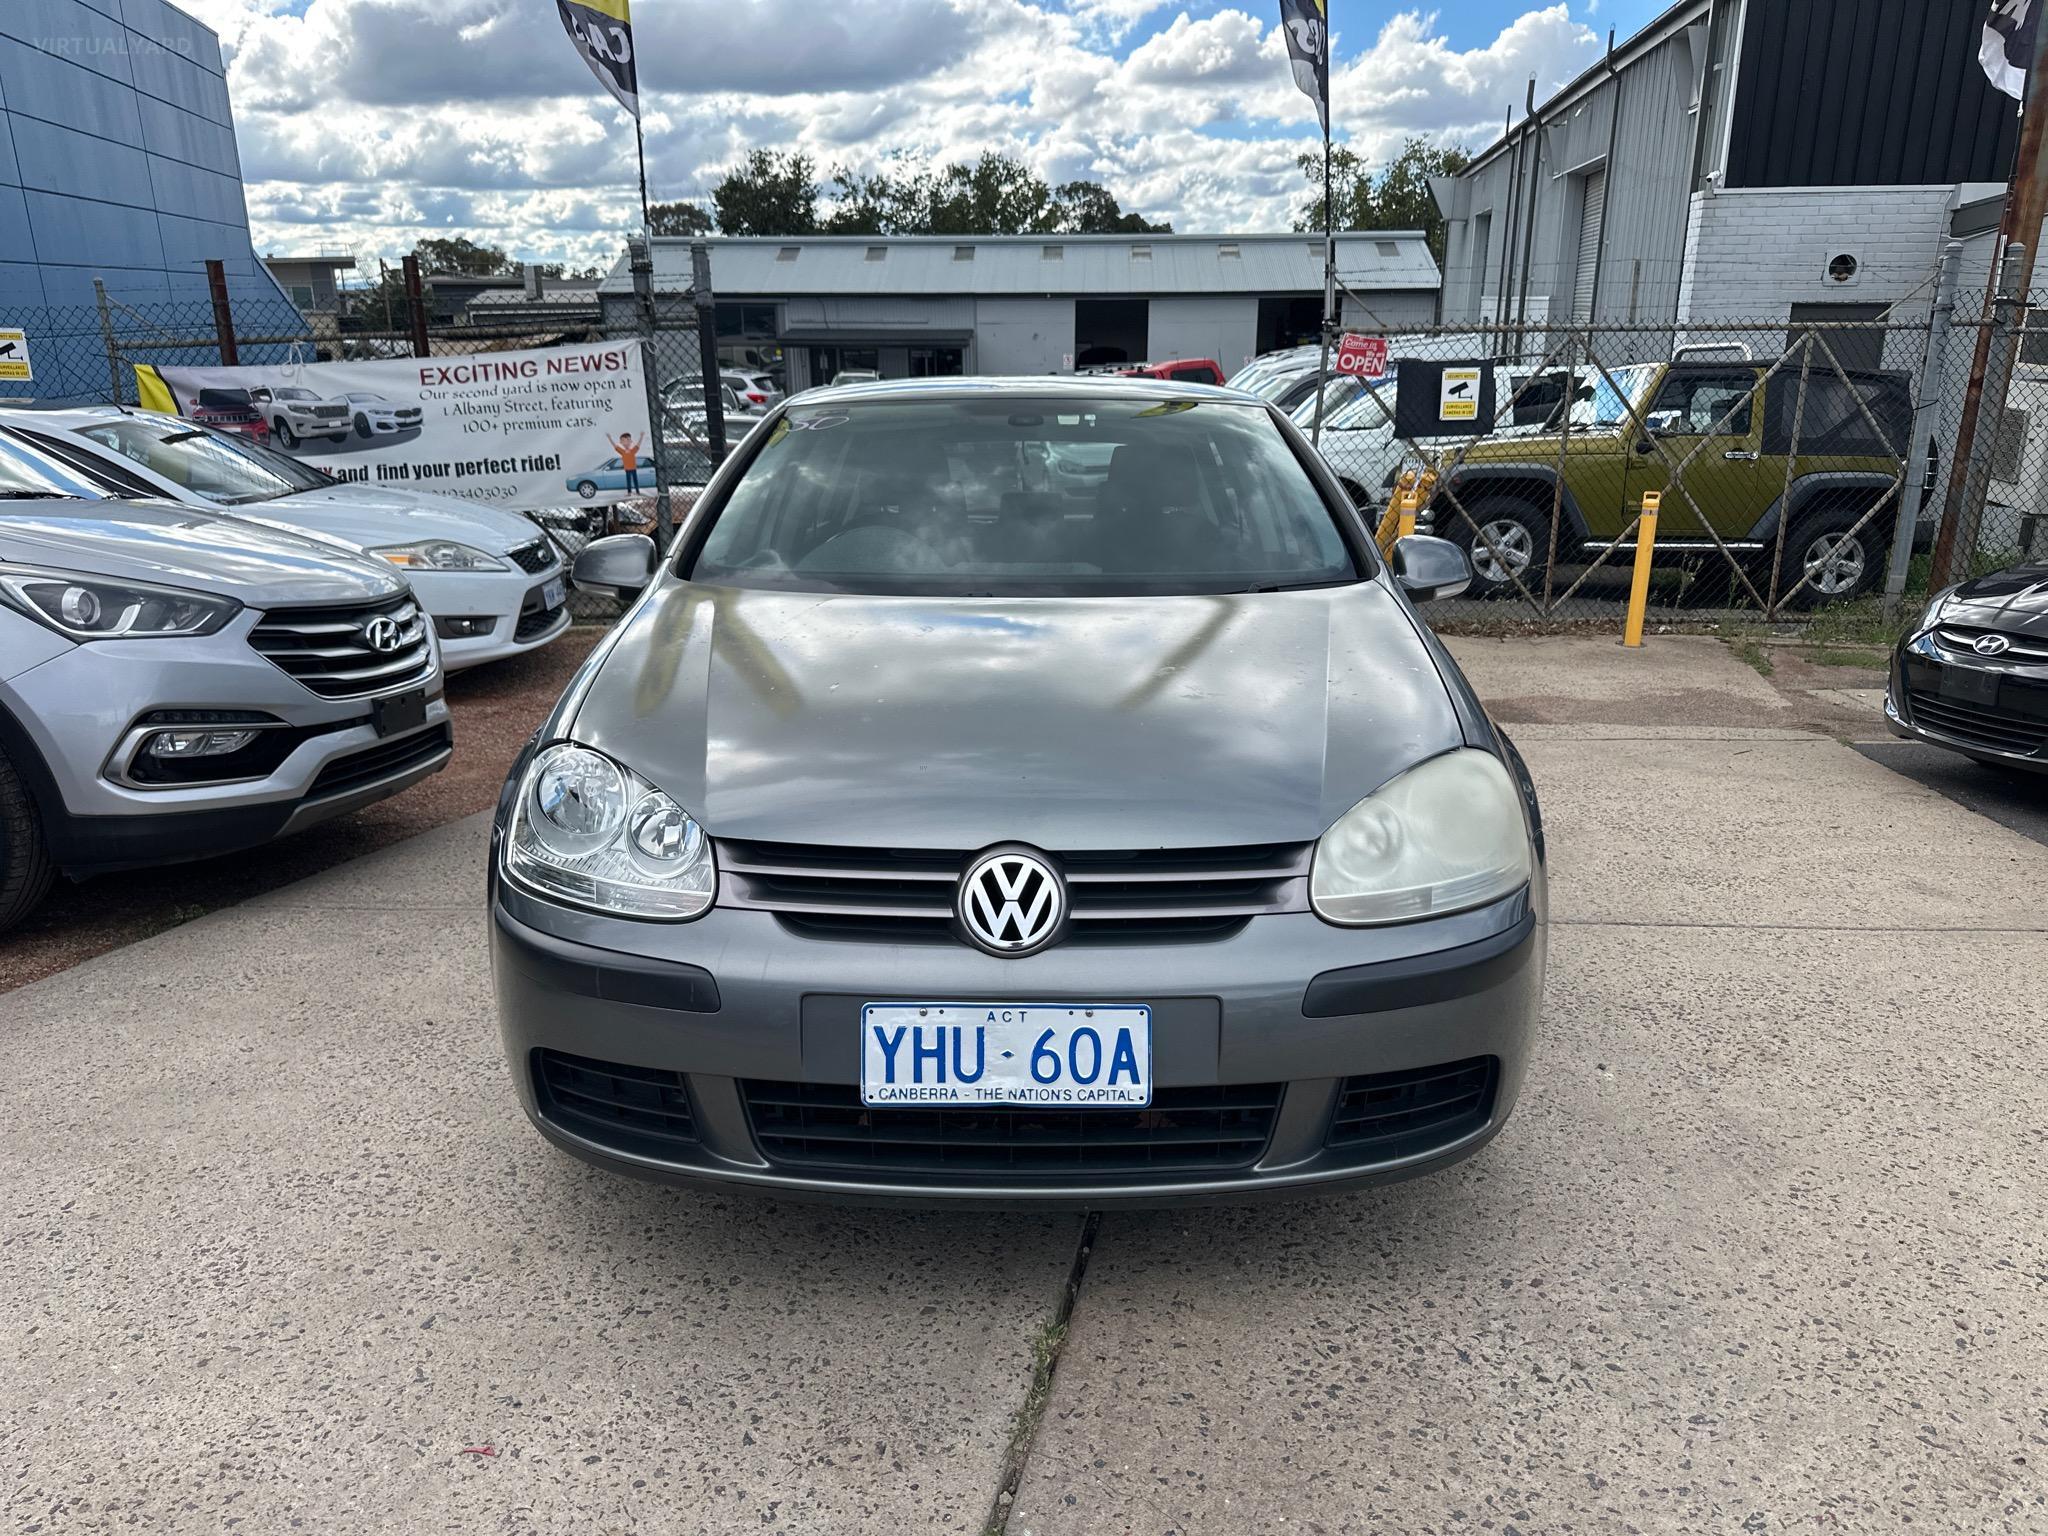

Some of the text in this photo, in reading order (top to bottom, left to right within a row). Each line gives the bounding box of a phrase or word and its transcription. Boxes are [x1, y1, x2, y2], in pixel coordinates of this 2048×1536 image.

[419, 351, 629, 386] EXCITING NEWS!
[1340, 353, 1385, 373] OPEN
[419, 378, 632, 401] Our second yard is now open at
[452, 402, 500, 418] Albany
[551, 396, 613, 413] featuring
[463, 416, 597, 436] 100+ premium cars.
[337, 465, 369, 482] and
[377, 463, 409, 481] find
[412, 463, 450, 480] your
[455, 457, 518, 478] perfect
[521, 453, 562, 473] ride!
[986, 1010, 1028, 1023] ACT
[873, 1025, 1141, 1086] YHU 60A
[878, 1087, 959, 1101] CANBERRA
[975, 1087, 1003, 1100] THE
[1077, 1088, 1135, 1101] CAPITAL
